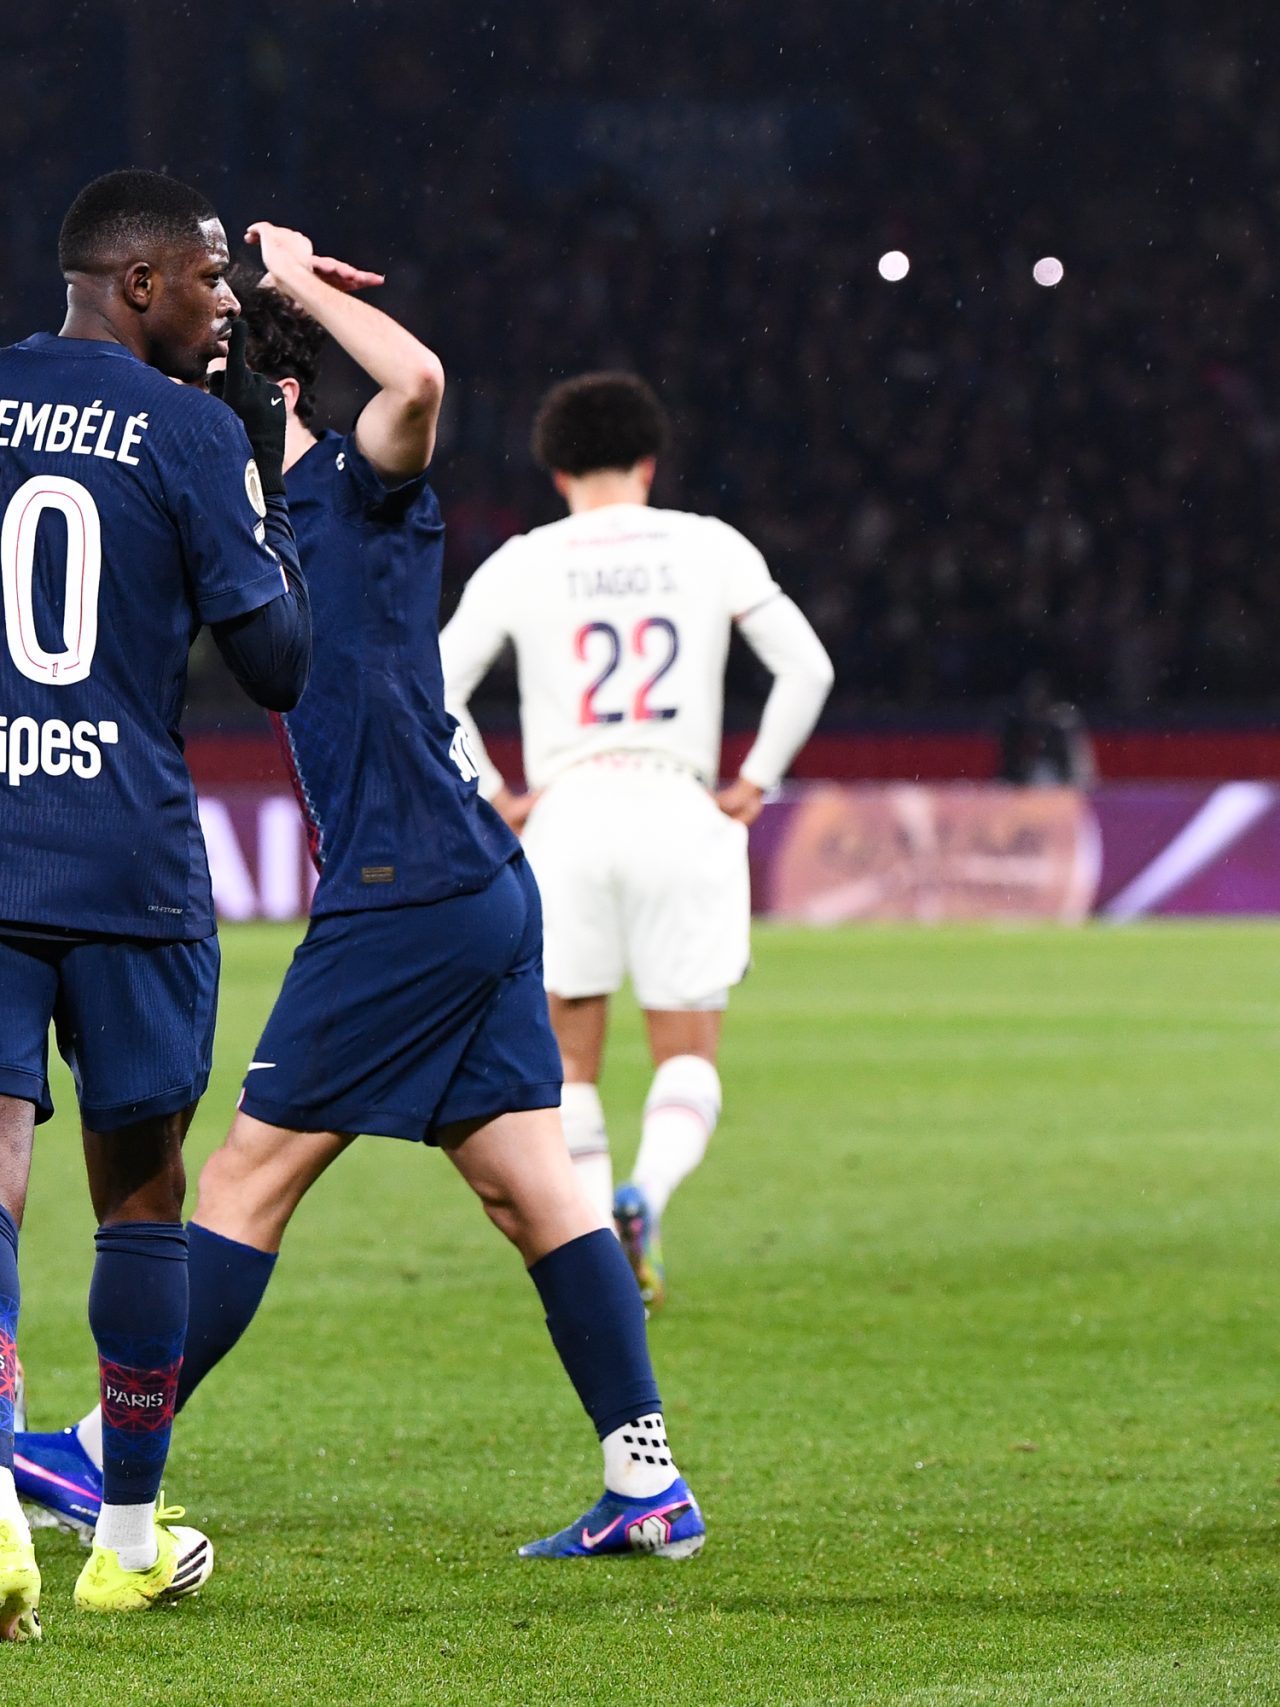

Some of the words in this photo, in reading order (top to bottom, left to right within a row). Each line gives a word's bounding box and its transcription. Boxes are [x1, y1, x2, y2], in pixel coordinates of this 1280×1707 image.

[567, 563, 651, 602] TIAGO
[575, 617, 678, 725] 22
[106, 1385, 163, 1408] PARIS
